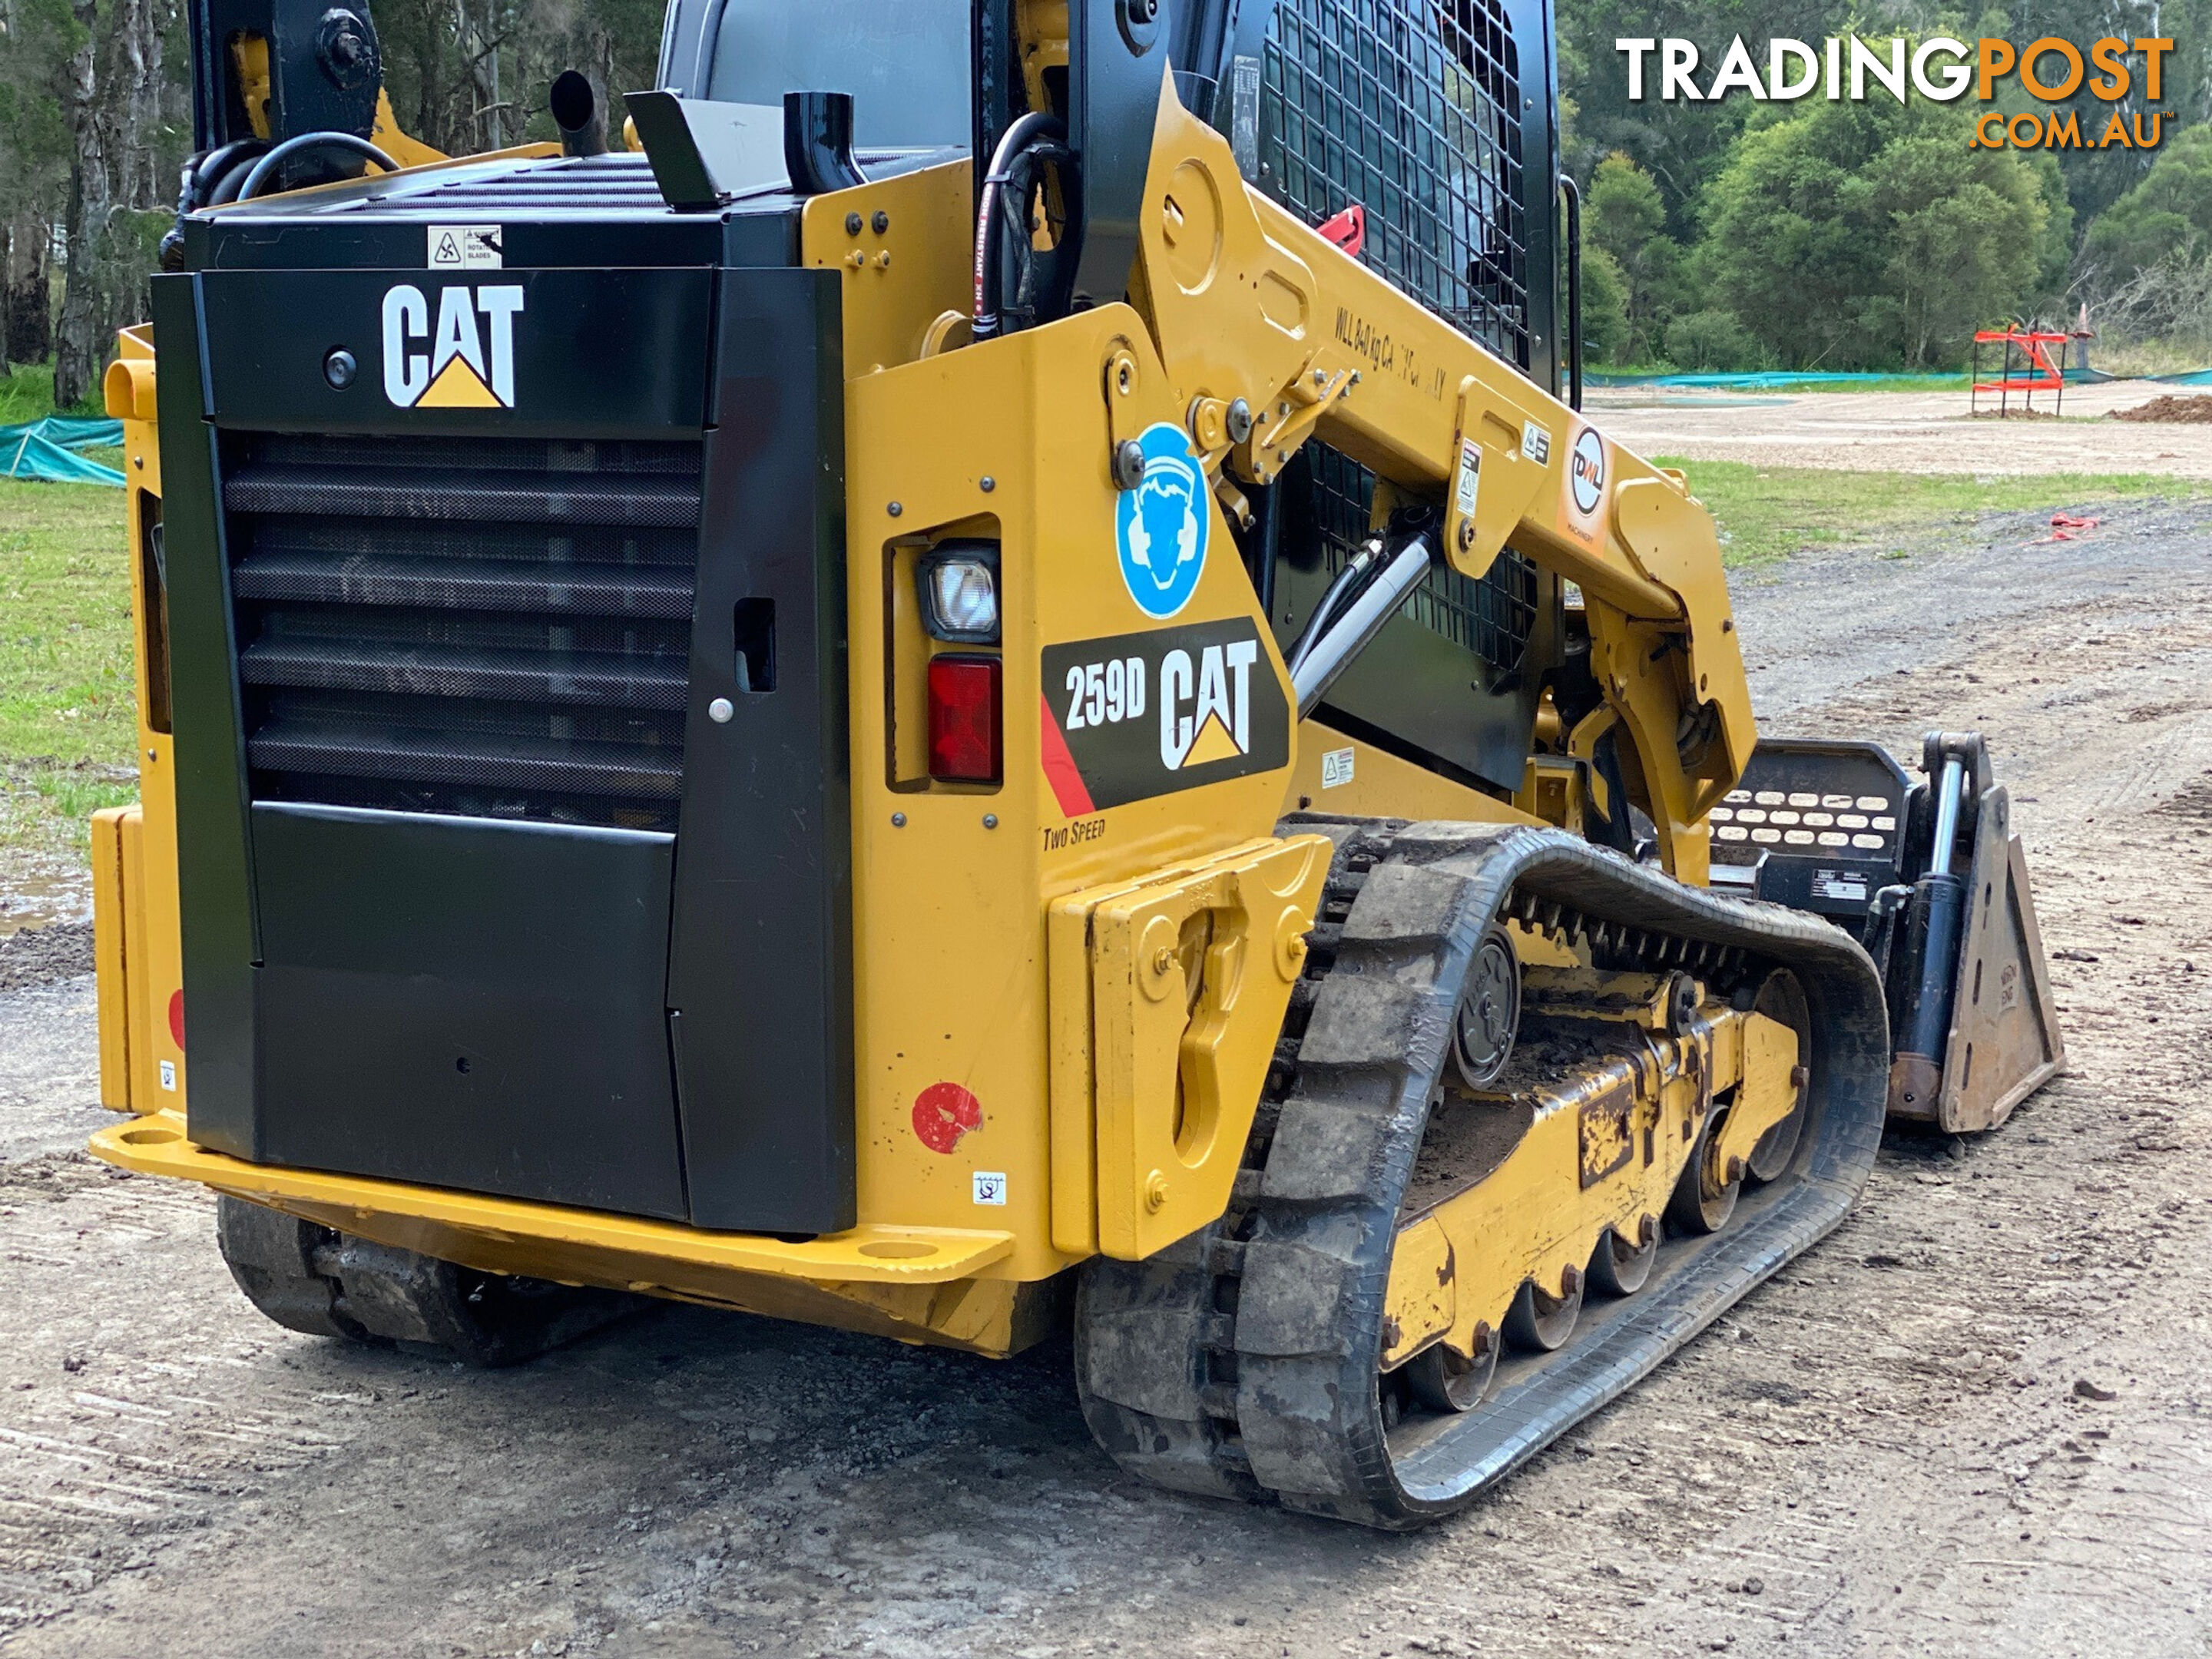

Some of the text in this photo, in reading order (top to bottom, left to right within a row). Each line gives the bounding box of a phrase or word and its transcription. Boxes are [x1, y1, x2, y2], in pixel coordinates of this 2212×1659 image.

[976, 219, 987, 278] RESISTANT
[382, 284, 525, 408] CAT
[1335, 306, 1353, 347] WLL
[1575, 449, 1602, 492] DWL
[1567, 522, 1594, 544] MACHINERY
[1065, 639, 1257, 770] 259D CAT
